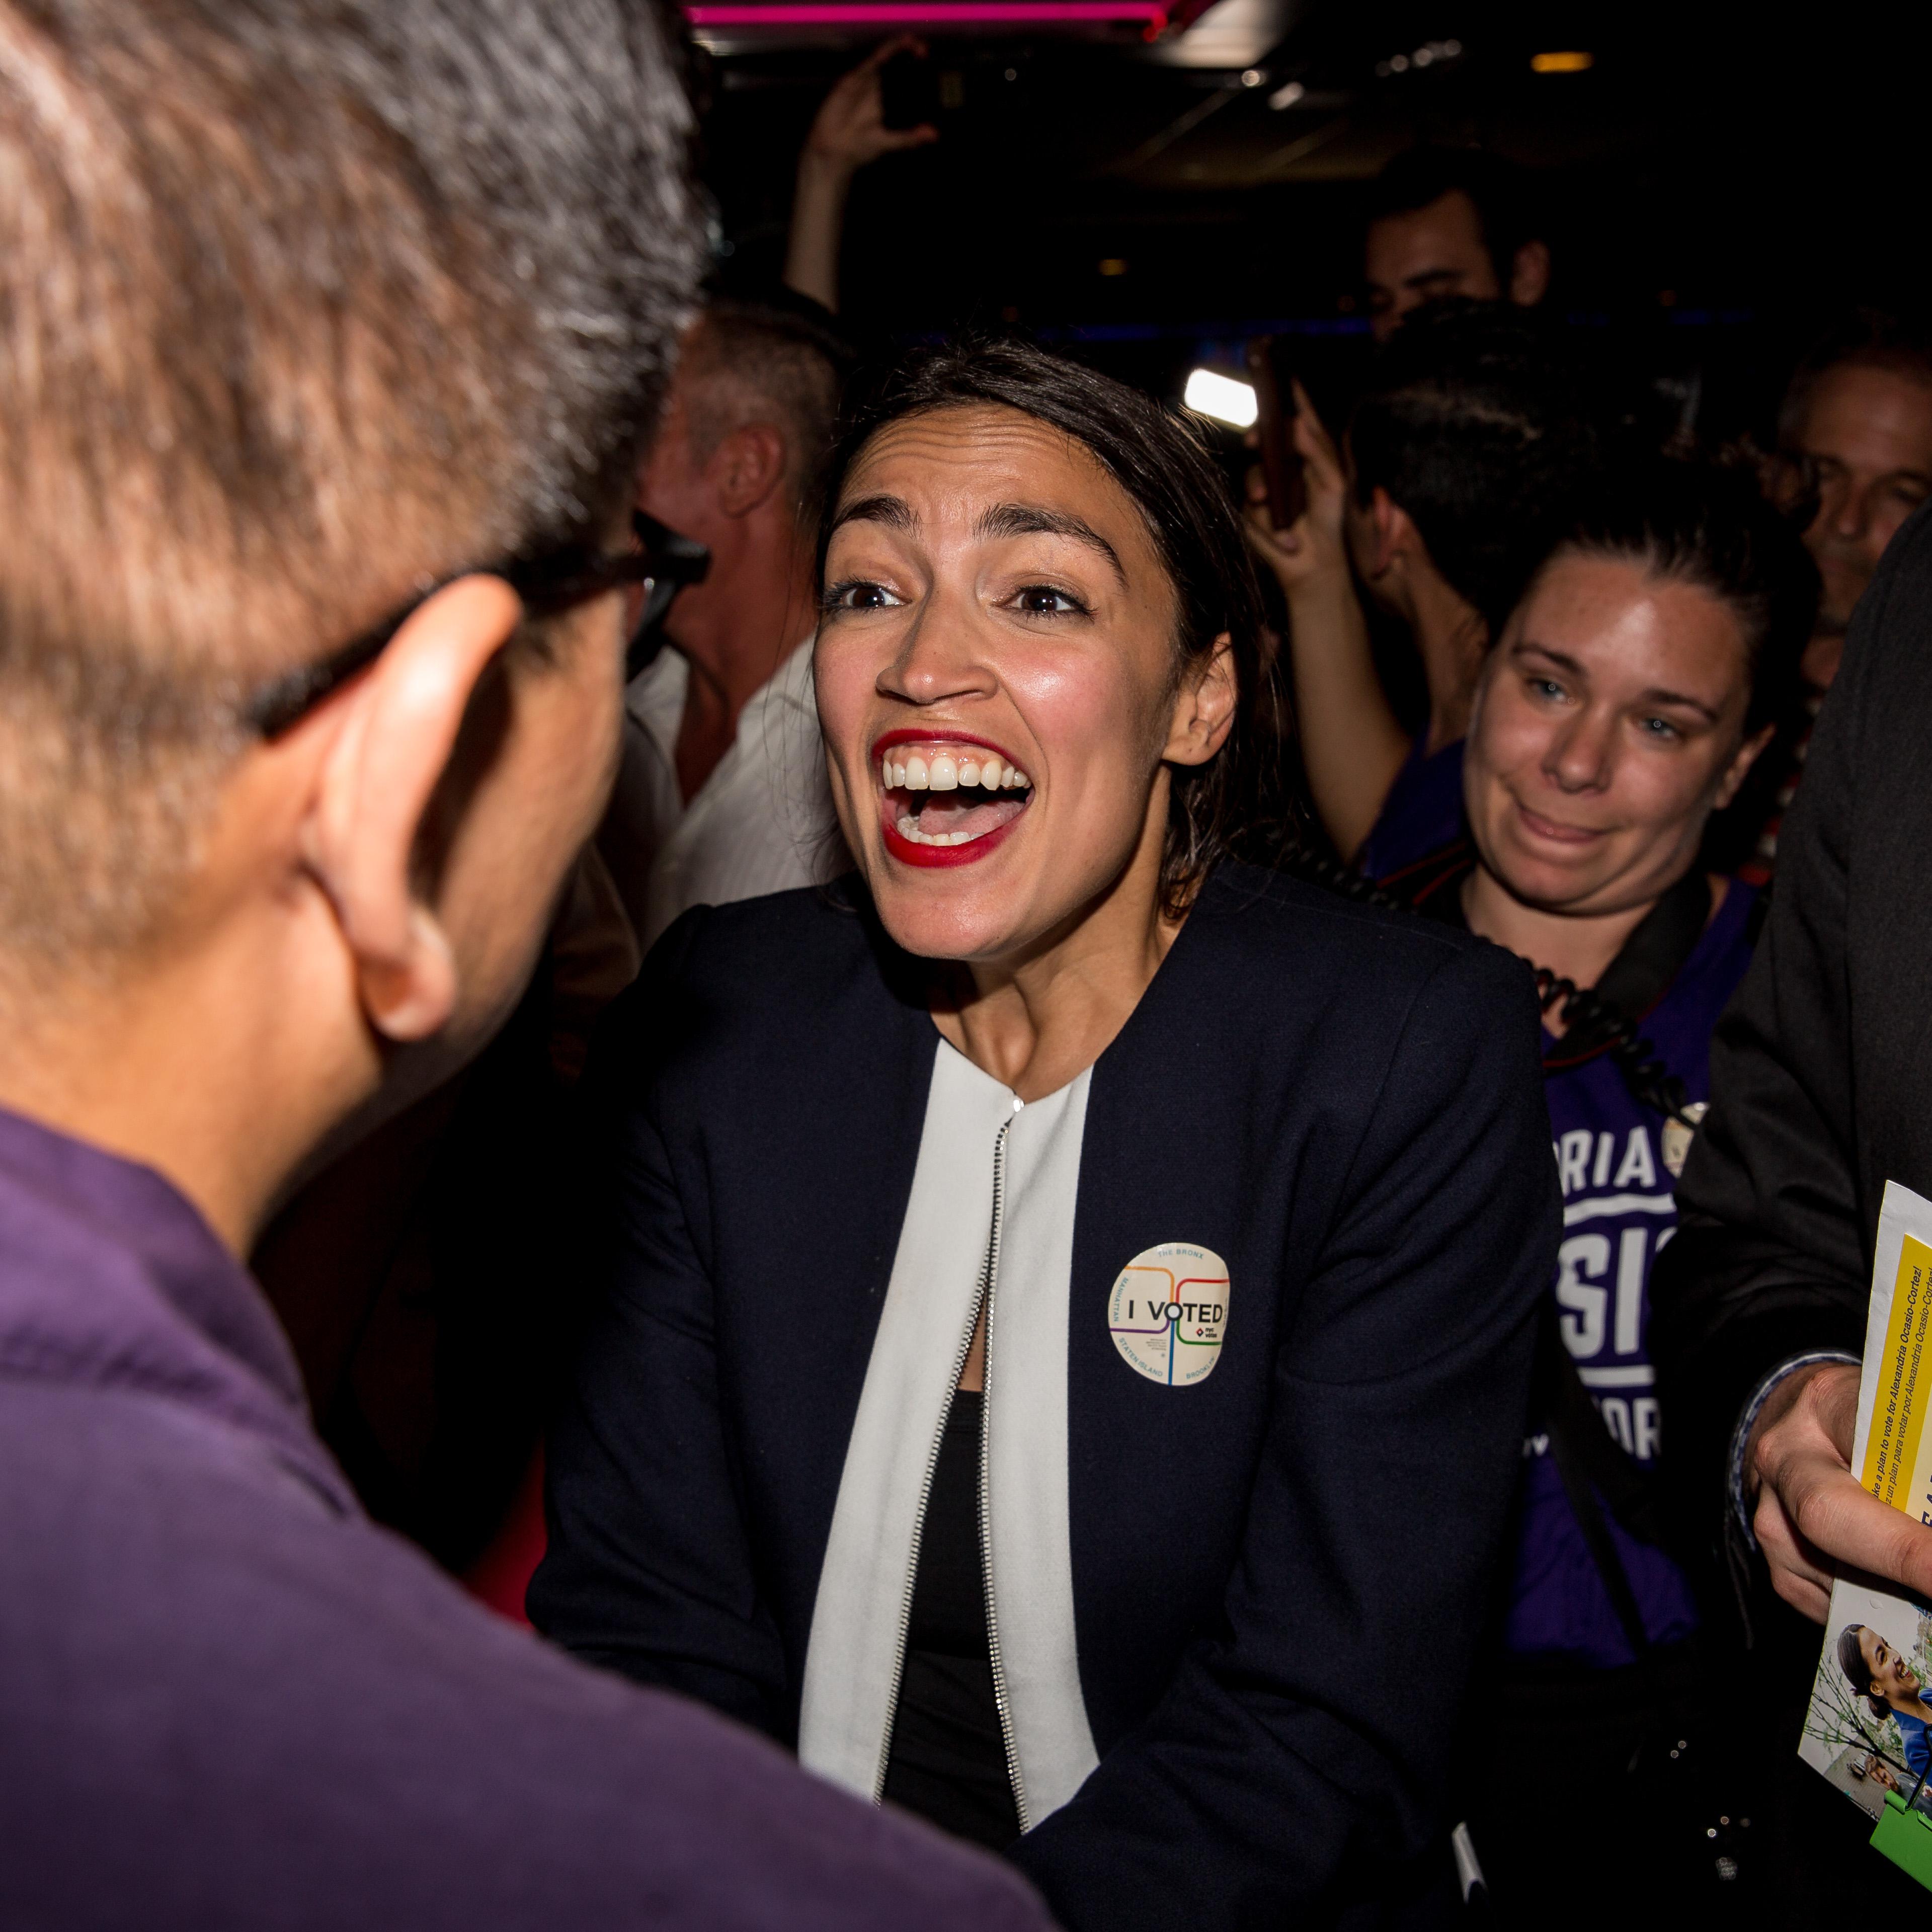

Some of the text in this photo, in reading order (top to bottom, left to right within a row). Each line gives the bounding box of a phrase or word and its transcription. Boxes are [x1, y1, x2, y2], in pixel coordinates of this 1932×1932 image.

[1553, 1125, 1657, 1197] RIA
[1158, 1248, 1204, 1259] THE BRONX
[1113, 1276, 1129, 1322] MANHATTAN
[1557, 1226, 1678, 1359] SI
[1900, 1265, 1922, 1343] Ocasio-Cortez!
[1129, 1300, 1134, 1319] I
[1148, 1301, 1223, 1323] VOTED
[1119, 1337, 1139, 1362] STATEN
[1138, 1360, 1163, 1377] ISLAND
[1890, 1345, 1907, 1400] Alexandria
[1905, 1343, 1922, 1397] Alexandria
[1887, 1399, 1896, 1415] for
[1903, 1395, 1912, 1415] por
[1884, 1416, 1893, 1437] vote
[1898, 1413, 1908, 1438] votar
[1880, 1439, 1889, 1450] to
[1894, 1439, 1903, 1464] para
[1877, 1451, 1887, 1475] plan
[1889, 1463, 1899, 1486] plan
[1876, 1474, 1882, 1482] a
[1887, 1485, 1894, 1498] un
